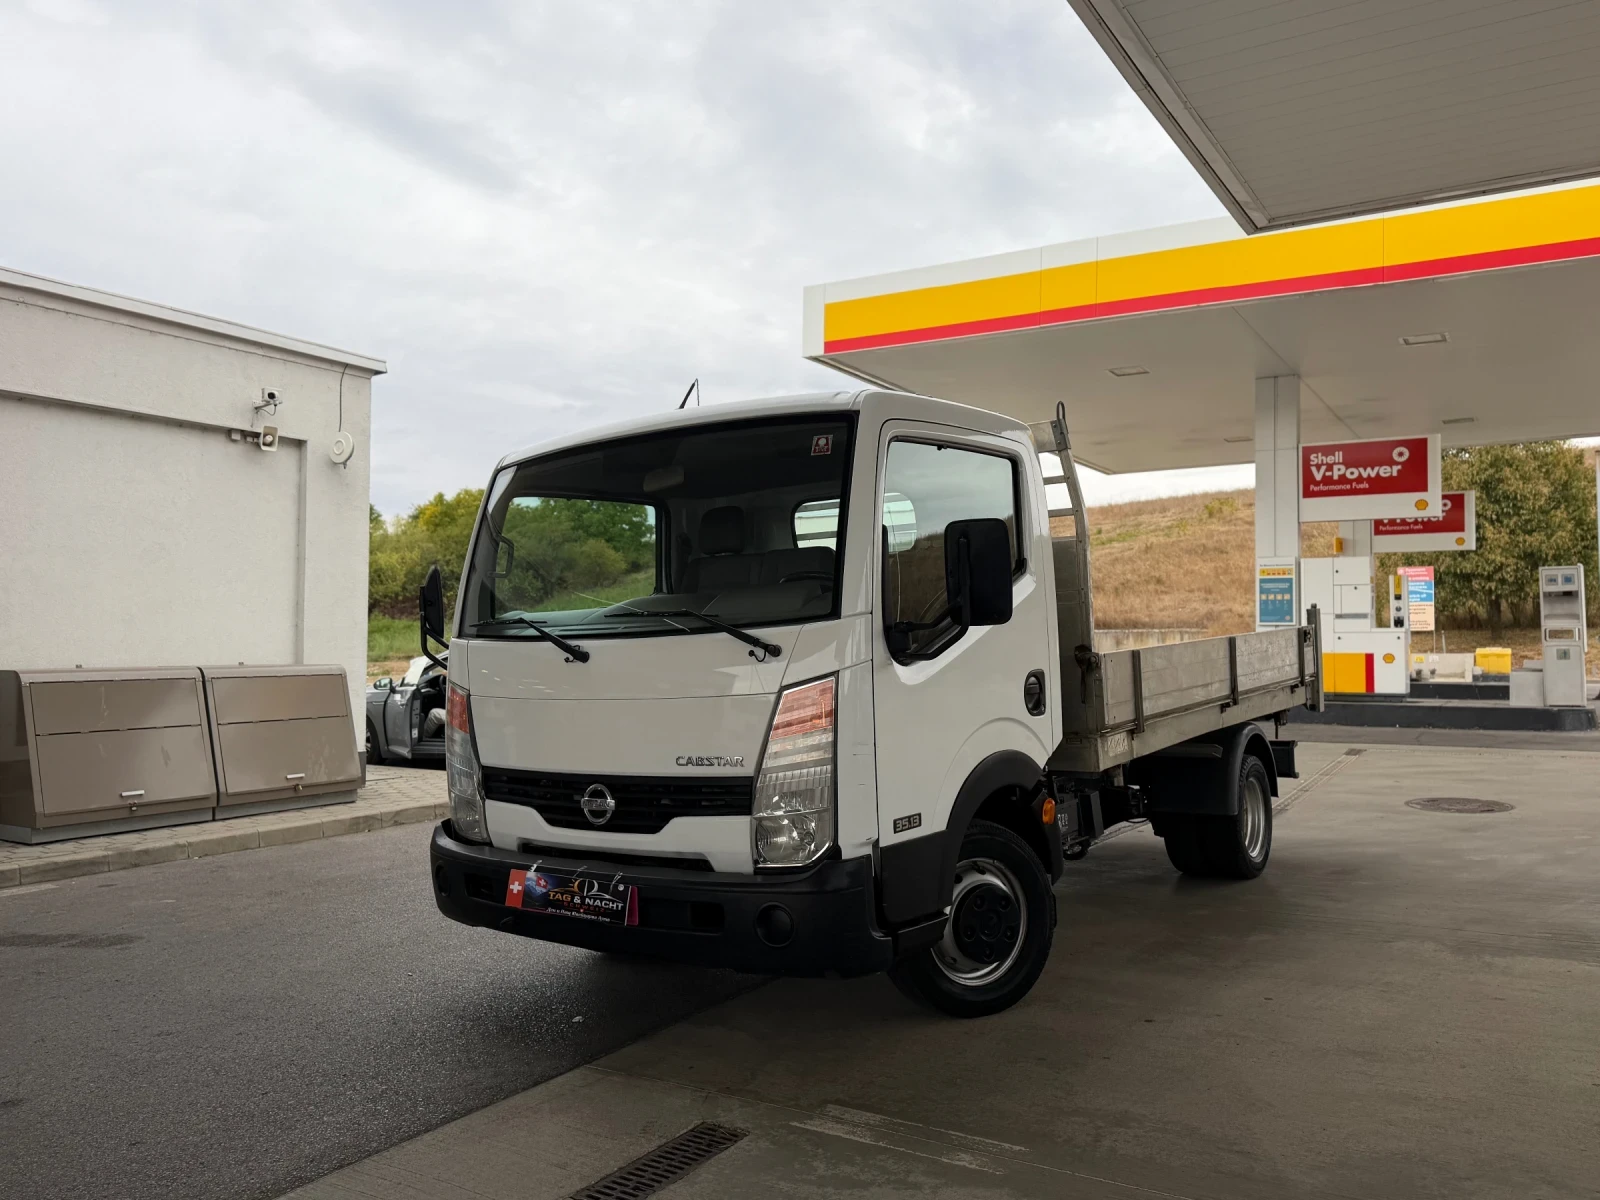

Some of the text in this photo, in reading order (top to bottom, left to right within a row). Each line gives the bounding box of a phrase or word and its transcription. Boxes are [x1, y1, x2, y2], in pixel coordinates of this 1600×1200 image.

[1309, 450, 1343, 465] Shell
[1310, 464, 1402, 481] V-Power
[1309, 481, 1370, 492] Performance Fuels
[1379, 524, 1410, 532] Performance
[675, 756, 745, 768] CABSTAR
[895, 814, 920, 832] 35.13
[548, 891, 624, 911] TAG & NACHT
